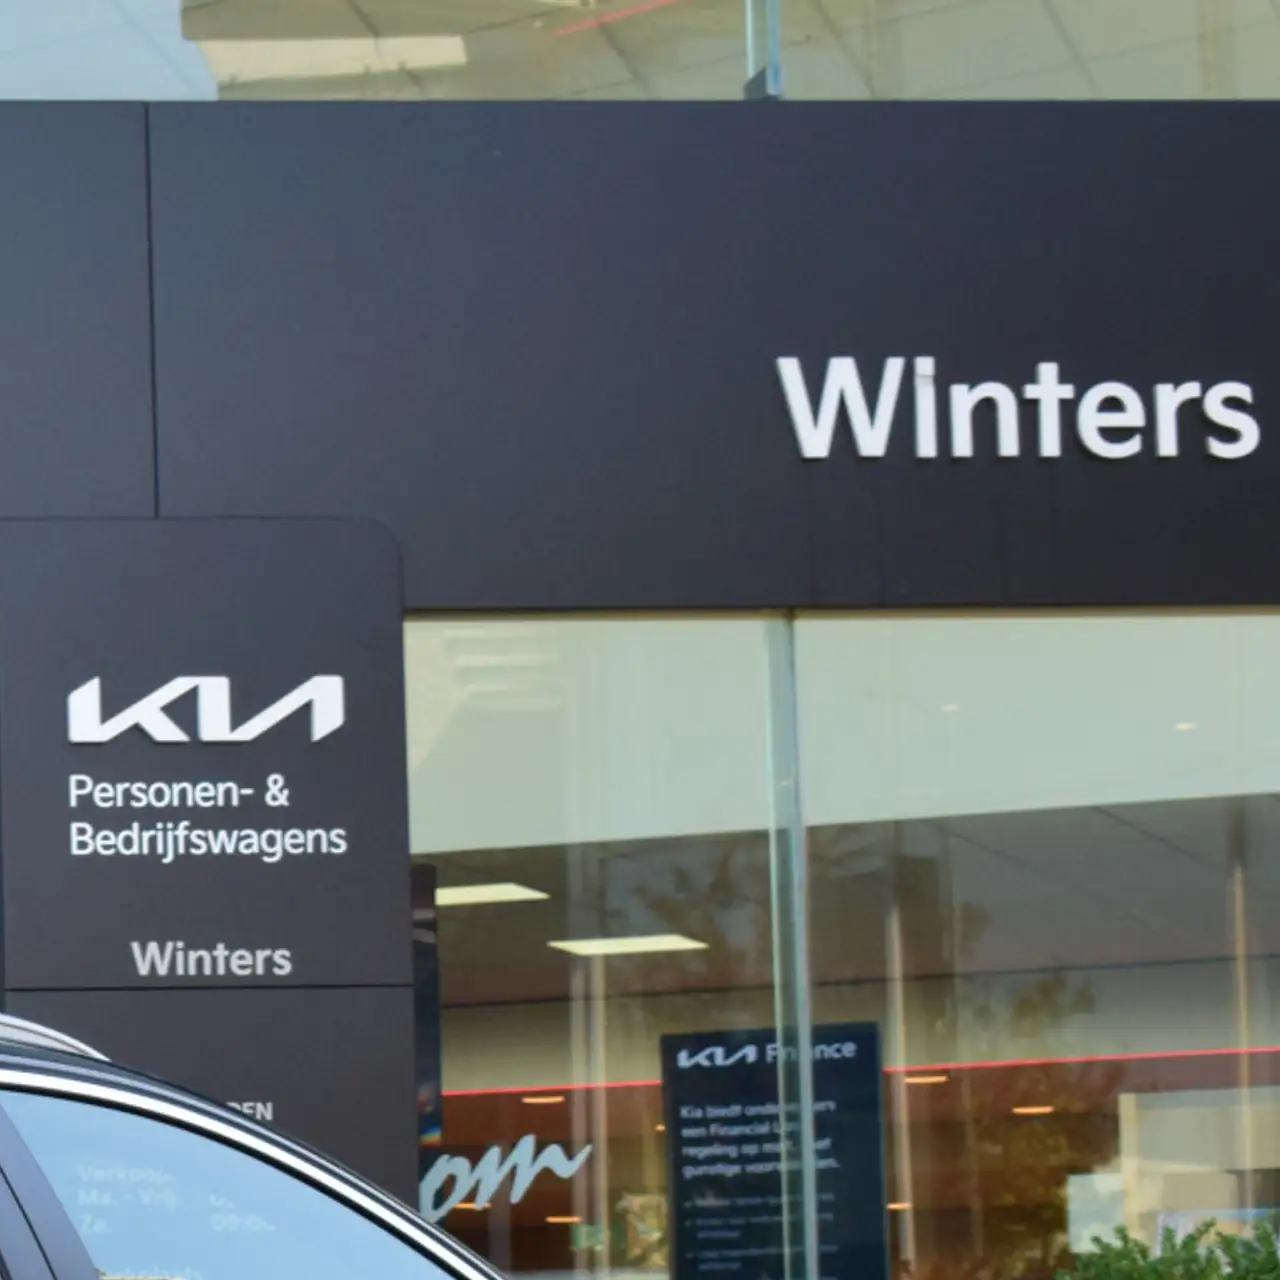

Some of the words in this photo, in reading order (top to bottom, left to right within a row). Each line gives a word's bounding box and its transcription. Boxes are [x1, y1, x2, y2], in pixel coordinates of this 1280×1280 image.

[776, 355, 1261, 460] Winters
[67, 674, 345, 743] KIA
[68, 773, 254, 808] Personen-
[264, 773, 290, 807] &
[69, 820, 348, 864] Bedrijfswagens
[130, 940, 292, 977] Winters
[677, 1044, 759, 1069] KIA
[765, 1041, 857, 1064] Fnnce
